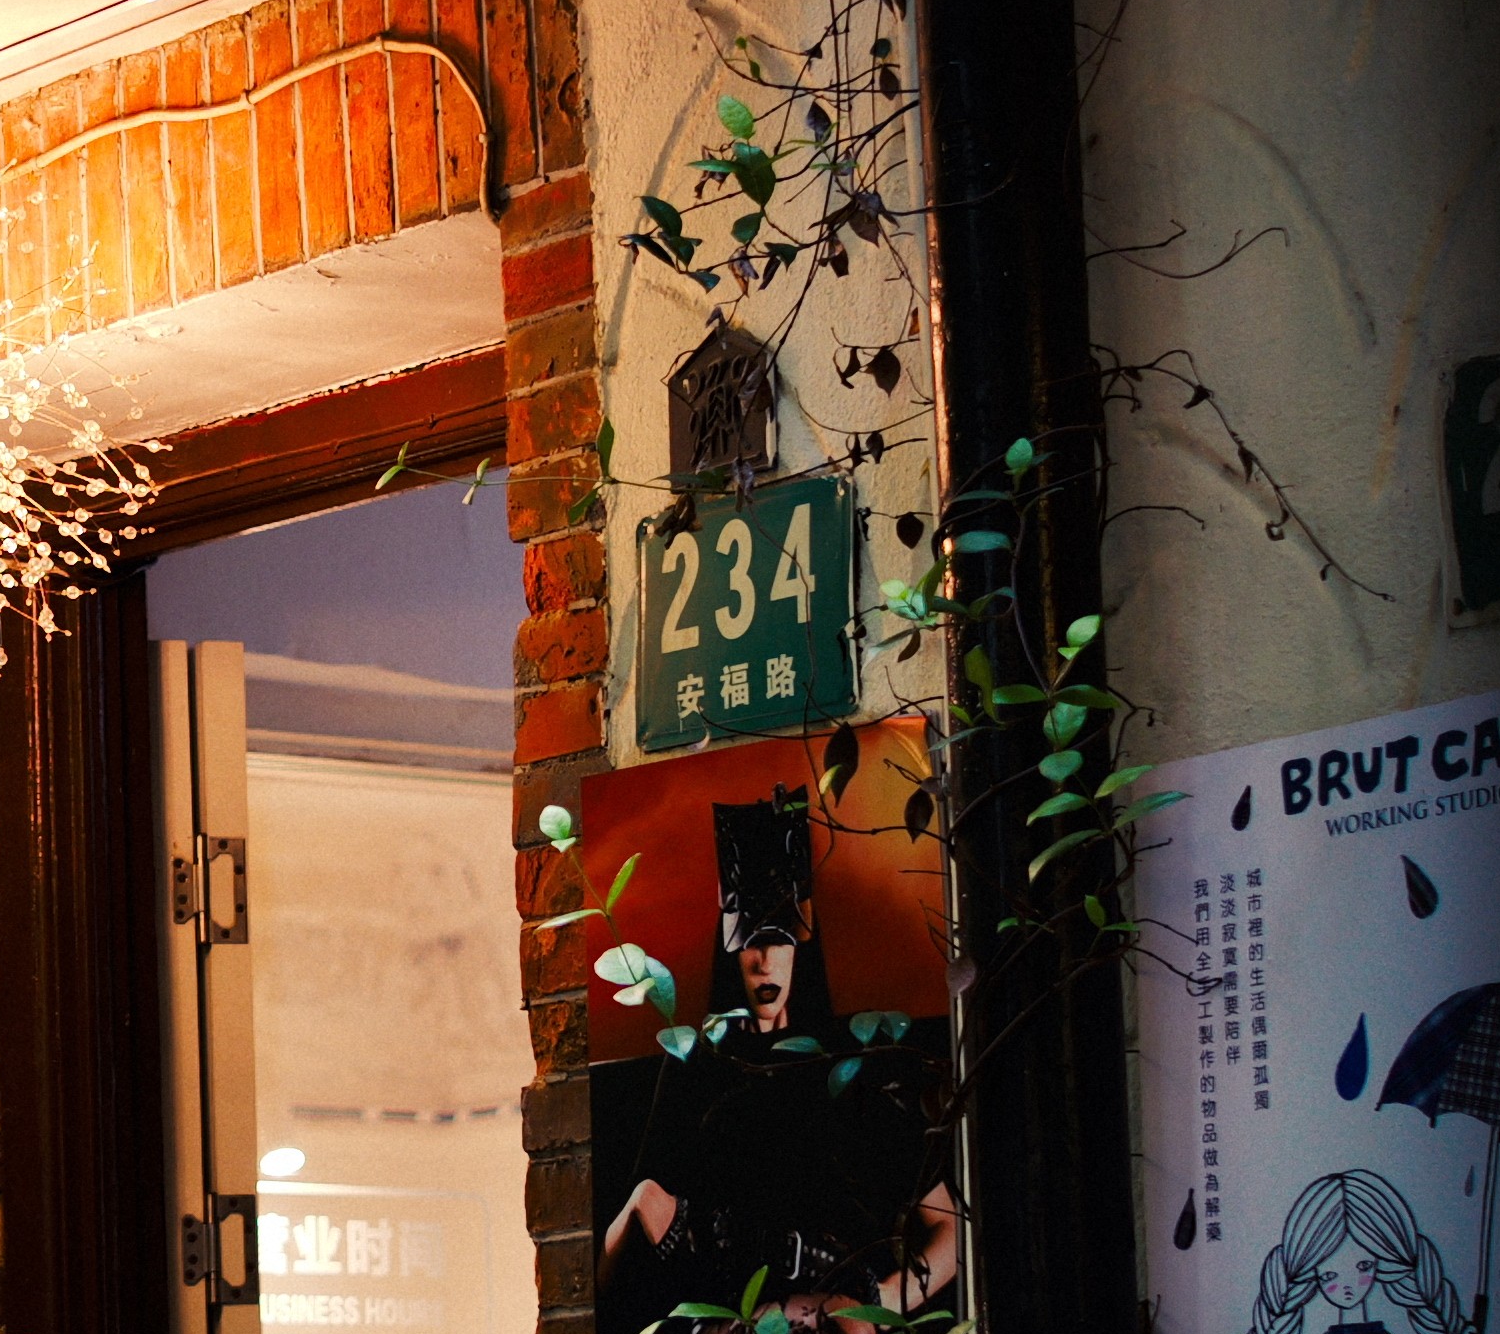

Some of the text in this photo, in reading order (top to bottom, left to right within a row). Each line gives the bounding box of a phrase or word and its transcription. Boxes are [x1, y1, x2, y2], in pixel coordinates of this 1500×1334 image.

[660, 503, 816, 654] 234
[676, 653, 797, 720] 安福路
[1281, 735, 1420, 816] BRUT
[1324, 799, 1429, 837] WORKING
[260, 1292, 360, 1326] USINESS
